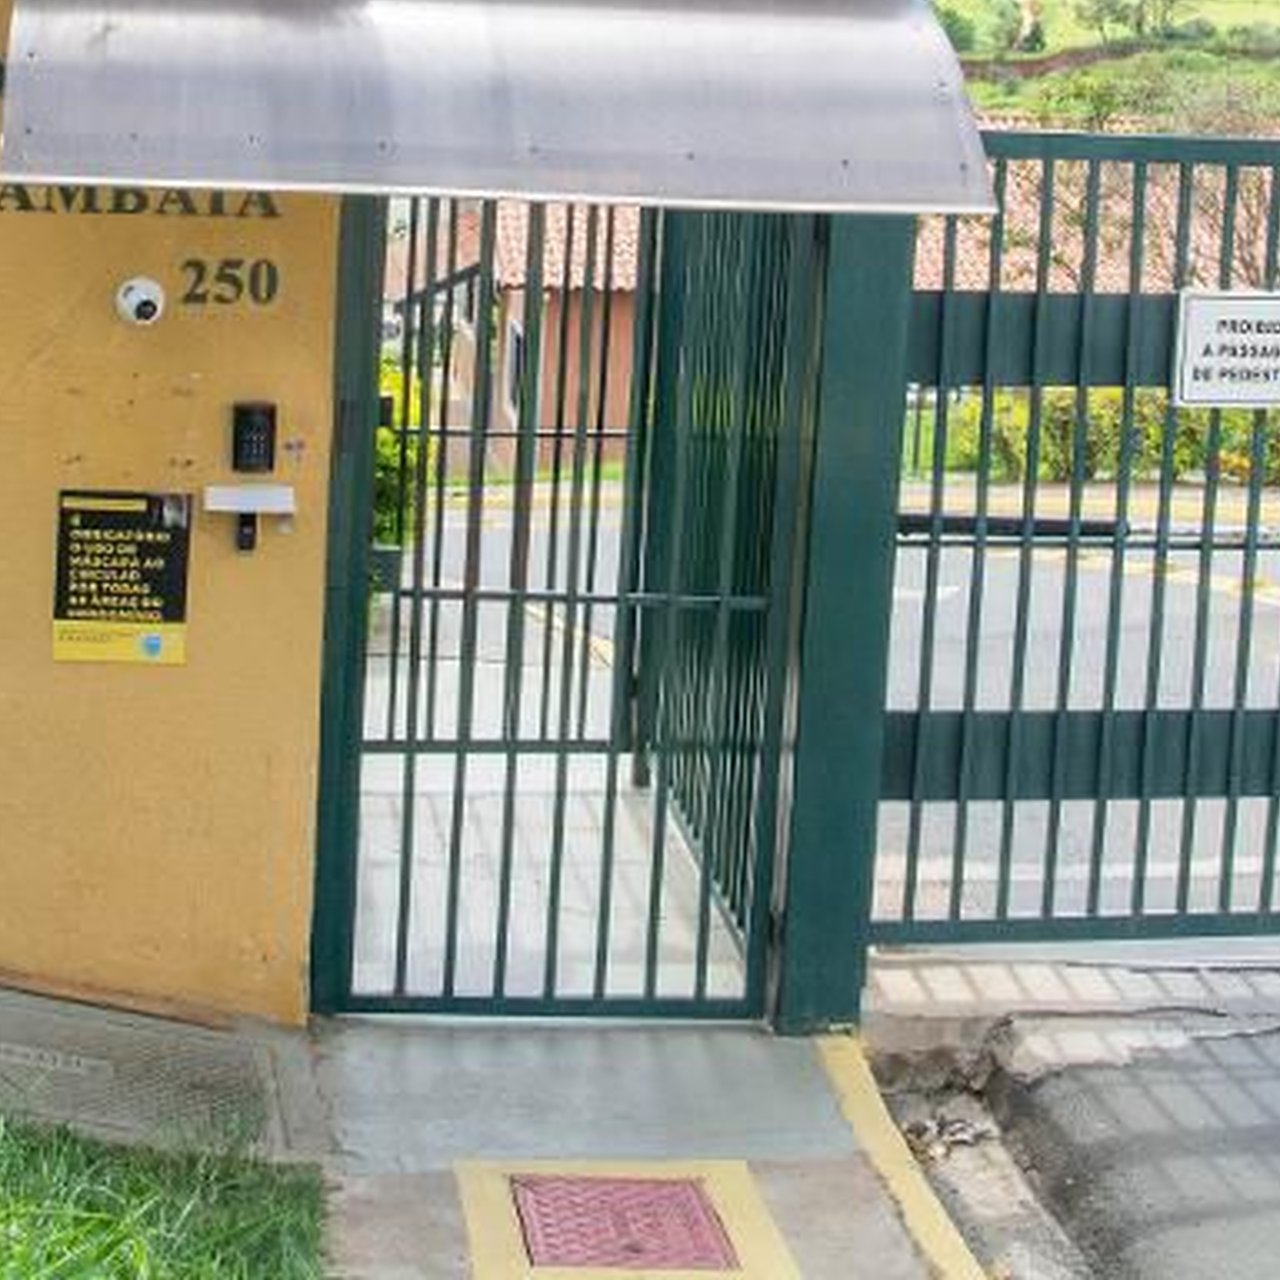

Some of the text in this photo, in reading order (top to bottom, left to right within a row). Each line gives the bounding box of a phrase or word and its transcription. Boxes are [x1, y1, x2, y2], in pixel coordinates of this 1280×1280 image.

[180, 258, 280, 307] 250
[1202, 343, 1214, 358] A
[1192, 367, 1212, 382] DE
